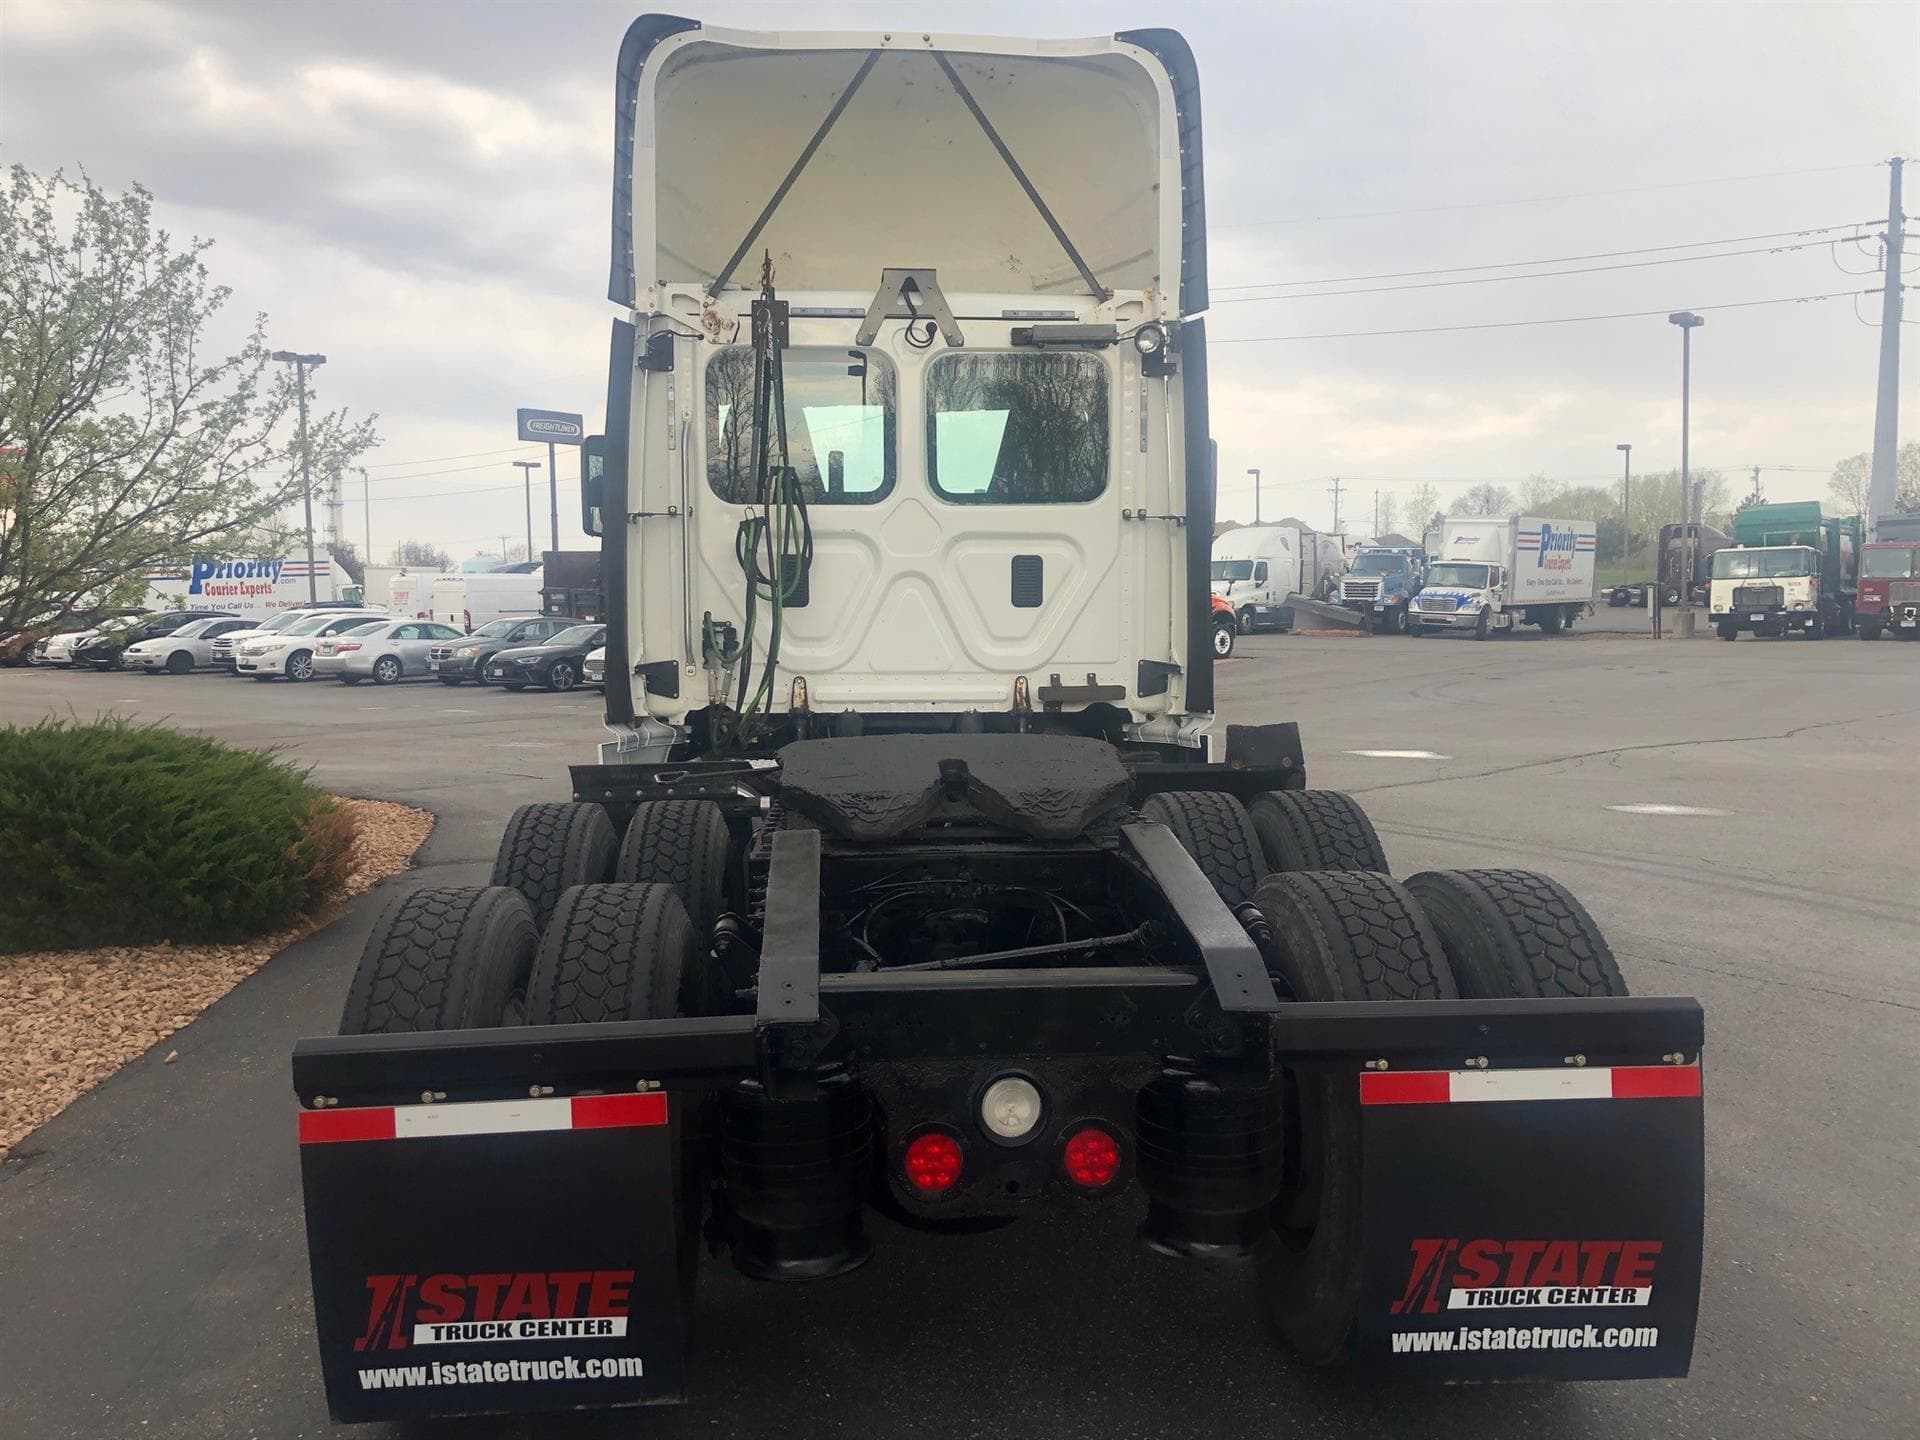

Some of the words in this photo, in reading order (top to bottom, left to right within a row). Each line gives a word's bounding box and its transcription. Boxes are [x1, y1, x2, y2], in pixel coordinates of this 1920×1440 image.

[532, 421, 576, 433] FREIGHTLINER
[1537, 523, 1578, 567] Priority
[189, 553, 283, 594] Priority
[205, 582, 238, 597] Courier
[239, 581, 273, 598] Experts
[211, 603, 226, 611] You
[227, 602, 242, 610] Call
[1465, 1289, 1542, 1306] TRUCK
[1547, 1288, 1637, 1305] CENTER
[431, 1322, 514, 1341] TRUCK
[519, 1319, 613, 1337] CENTER
[1392, 1324, 1659, 1353] www.istatetruck.com
[358, 1356, 644, 1390] www.istatetruck.com
